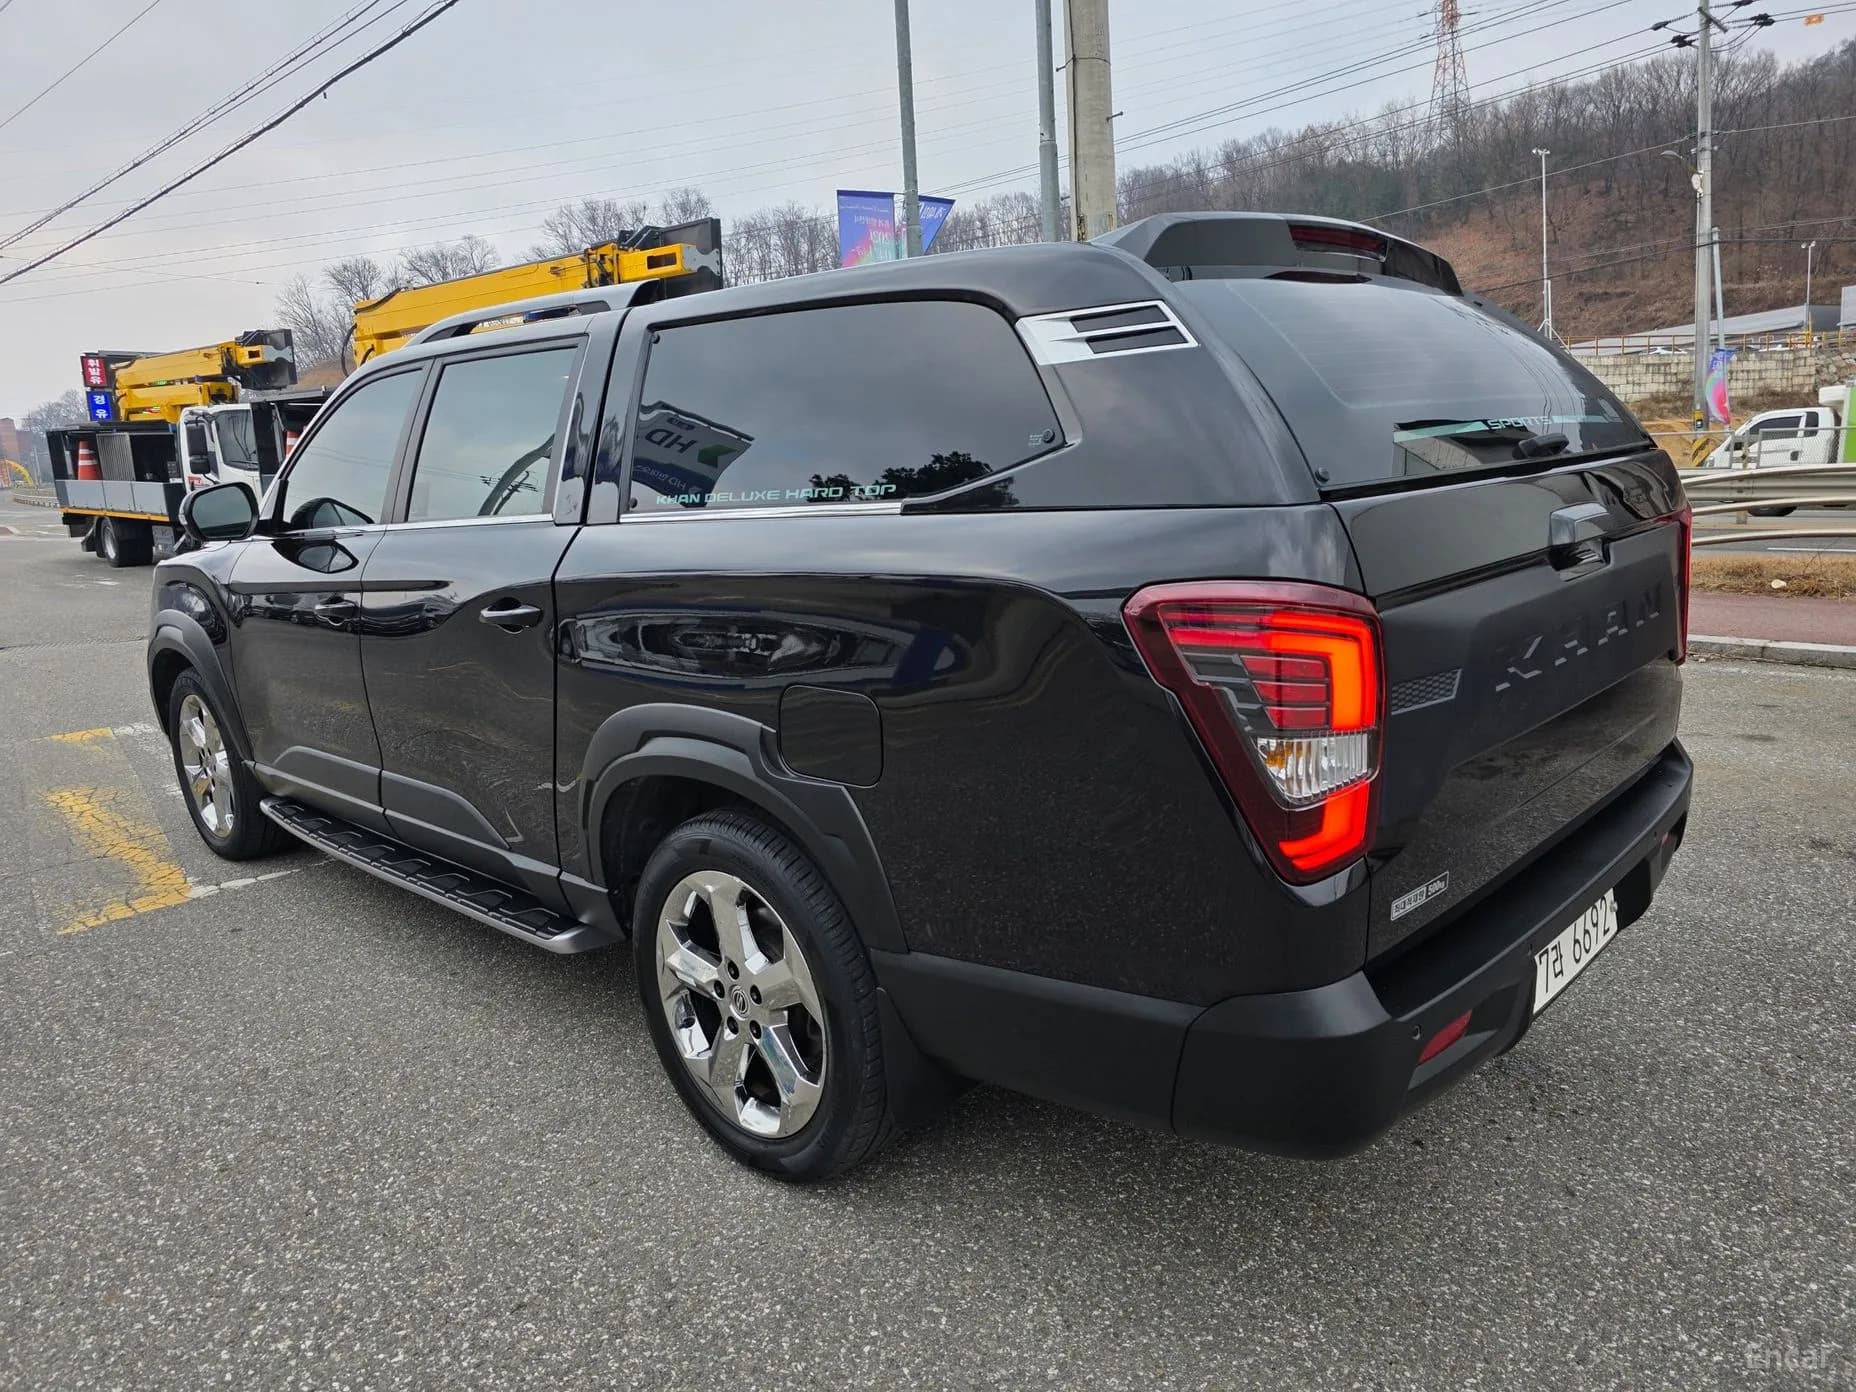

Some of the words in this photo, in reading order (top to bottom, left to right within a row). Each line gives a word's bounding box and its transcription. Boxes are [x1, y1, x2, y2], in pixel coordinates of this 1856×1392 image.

[1486, 415, 1552, 430] SPORTS
[656, 493, 700, 505] KHAN
[704, 489, 781, 504] DELUXE
[785, 486, 843, 499] HARD
[851, 483, 897, 497] TOP
[1572, 895, 1611, 965] 6692
